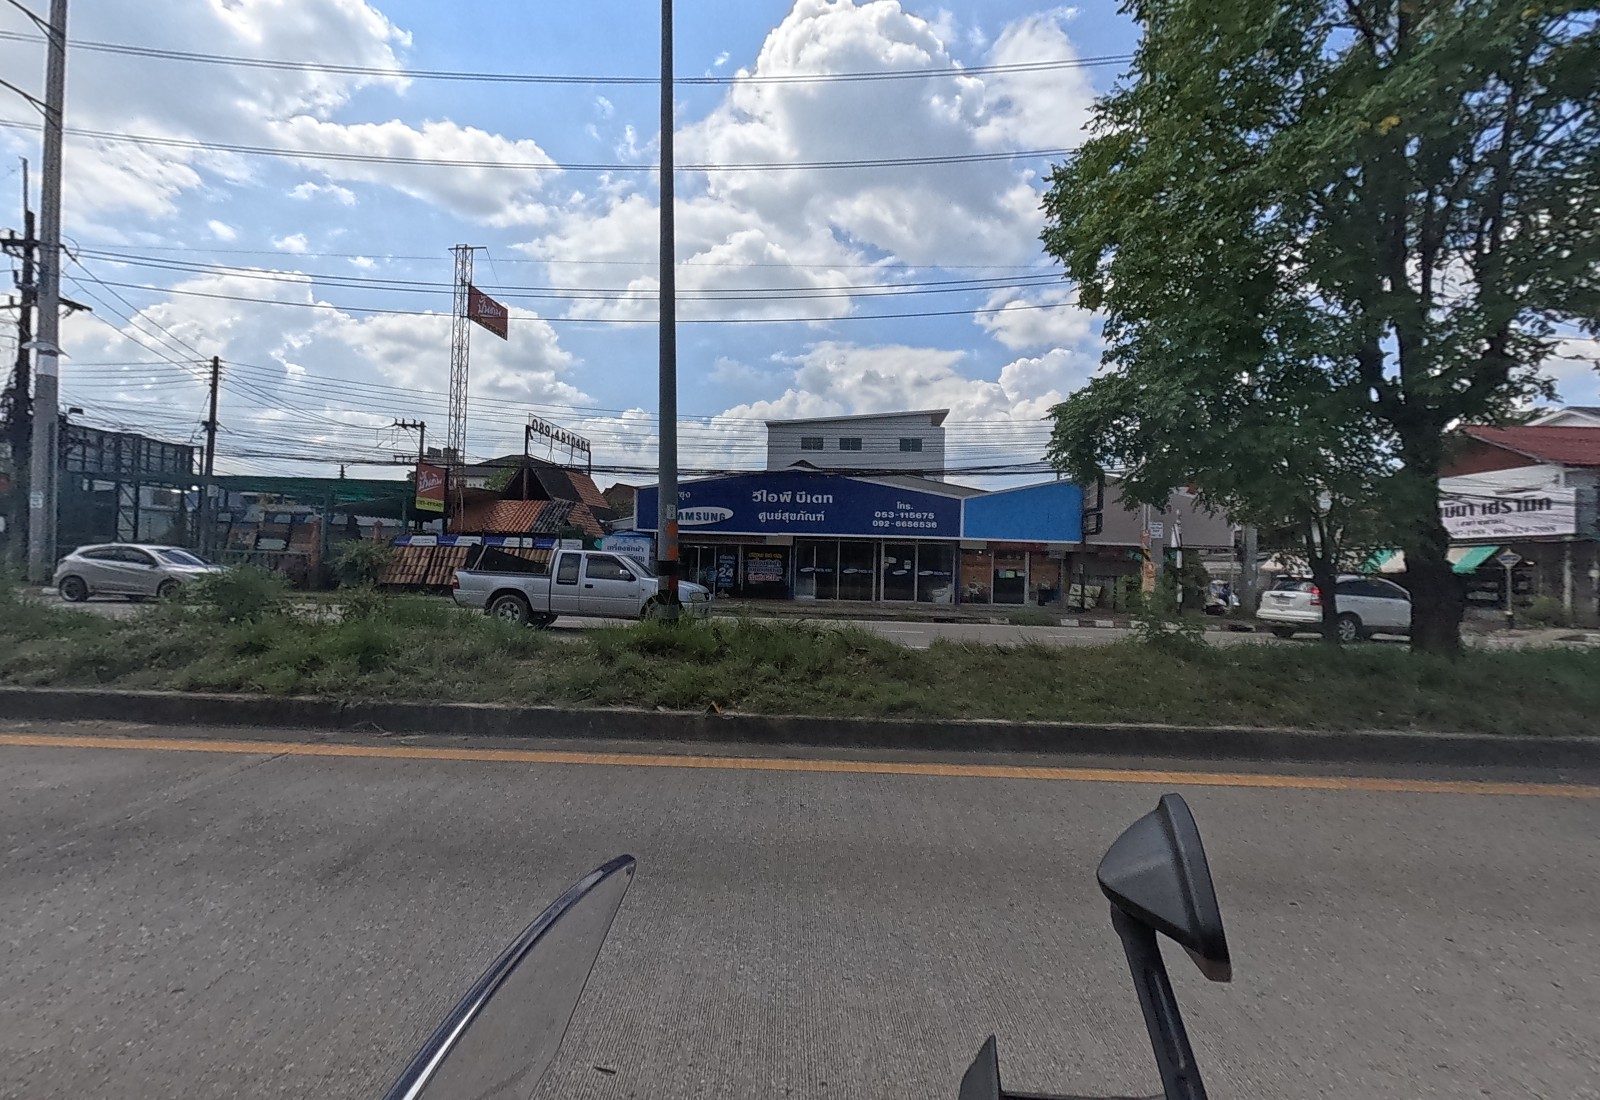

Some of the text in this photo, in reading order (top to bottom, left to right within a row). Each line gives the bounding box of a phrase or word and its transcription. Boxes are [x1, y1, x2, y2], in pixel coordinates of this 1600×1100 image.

[677, 511, 726, 521] AMSUNG
[758, 509, 825, 523] ศูนย์สุขภัณฑ์
[718, 567, 734, 578] 24
